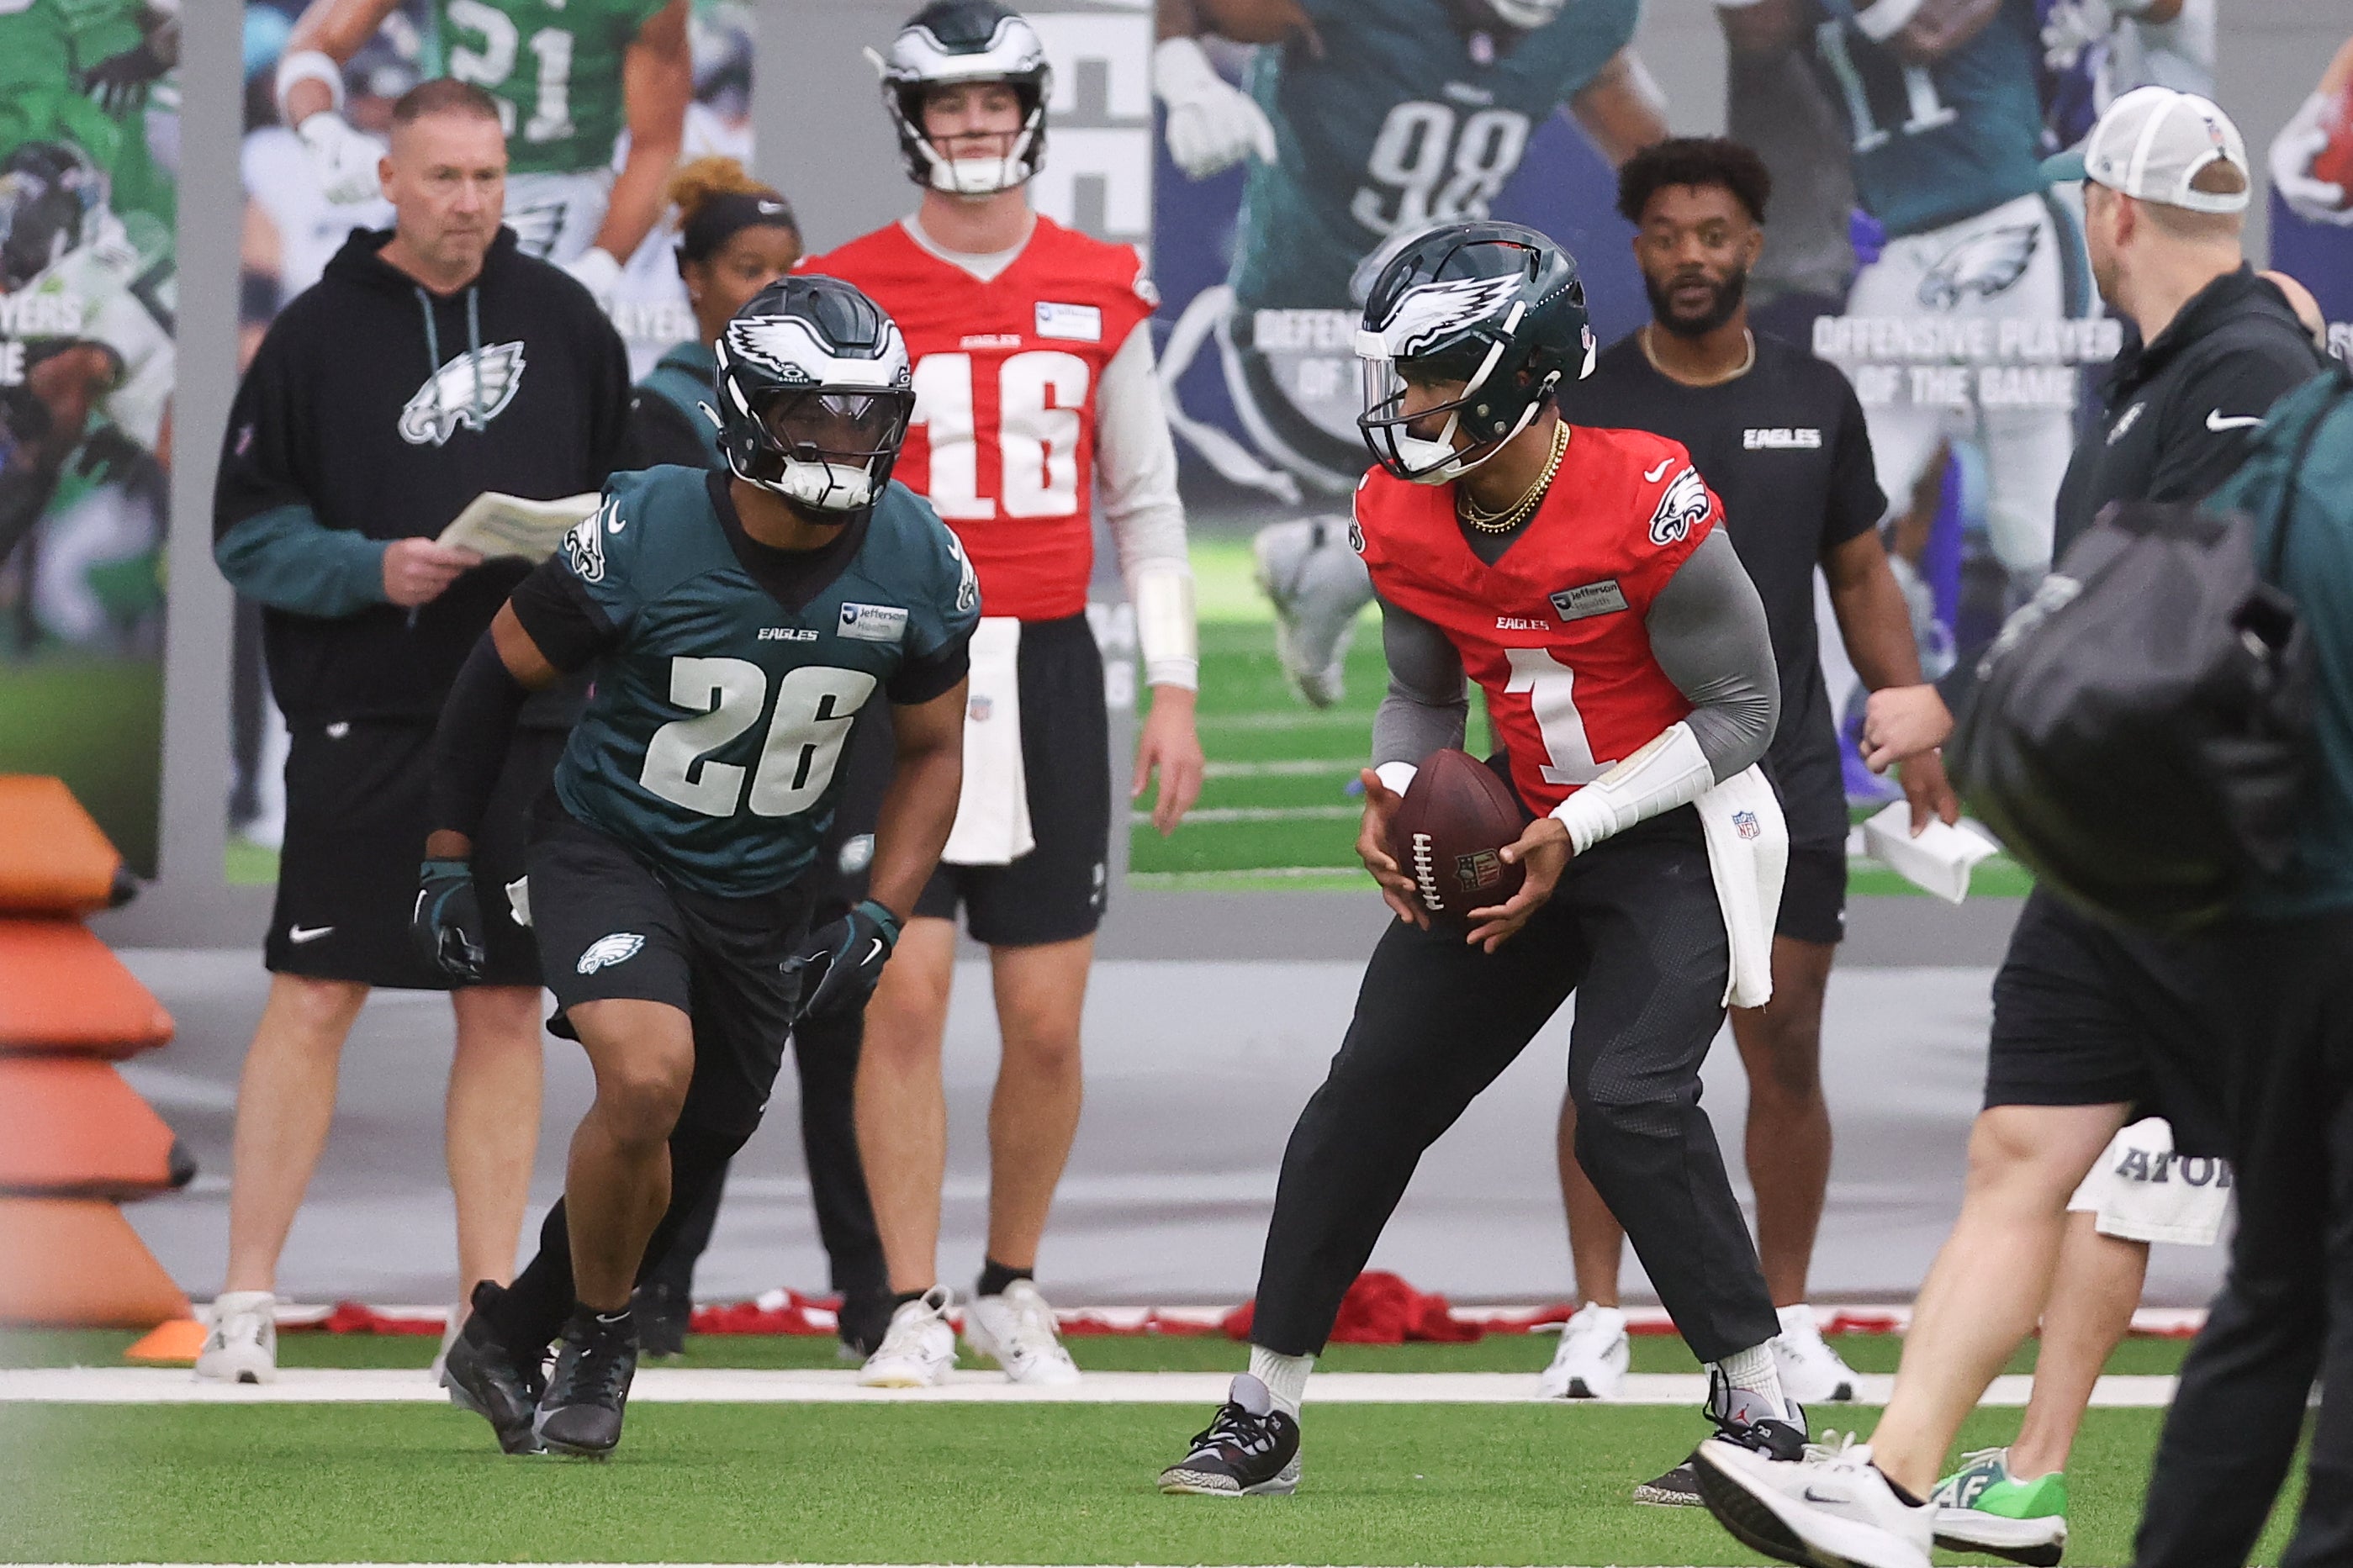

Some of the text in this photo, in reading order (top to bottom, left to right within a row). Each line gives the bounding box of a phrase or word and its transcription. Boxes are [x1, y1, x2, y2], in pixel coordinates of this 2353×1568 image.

[1351, 100, 1531, 236] 98
[1814, 318, 2120, 357] OFFENSIVE PLAYER
[1856, 367, 2073, 406] OF THE GAME
[907, 350, 1091, 520] 16
[1743, 427, 1822, 451] EAGLES
[859, 607, 907, 620] Jefferson
[1495, 616, 1550, 631] EAGLES
[757, 627, 820, 641] EAGLES
[1504, 647, 1617, 785] 1
[639, 656, 877, 817] 26
